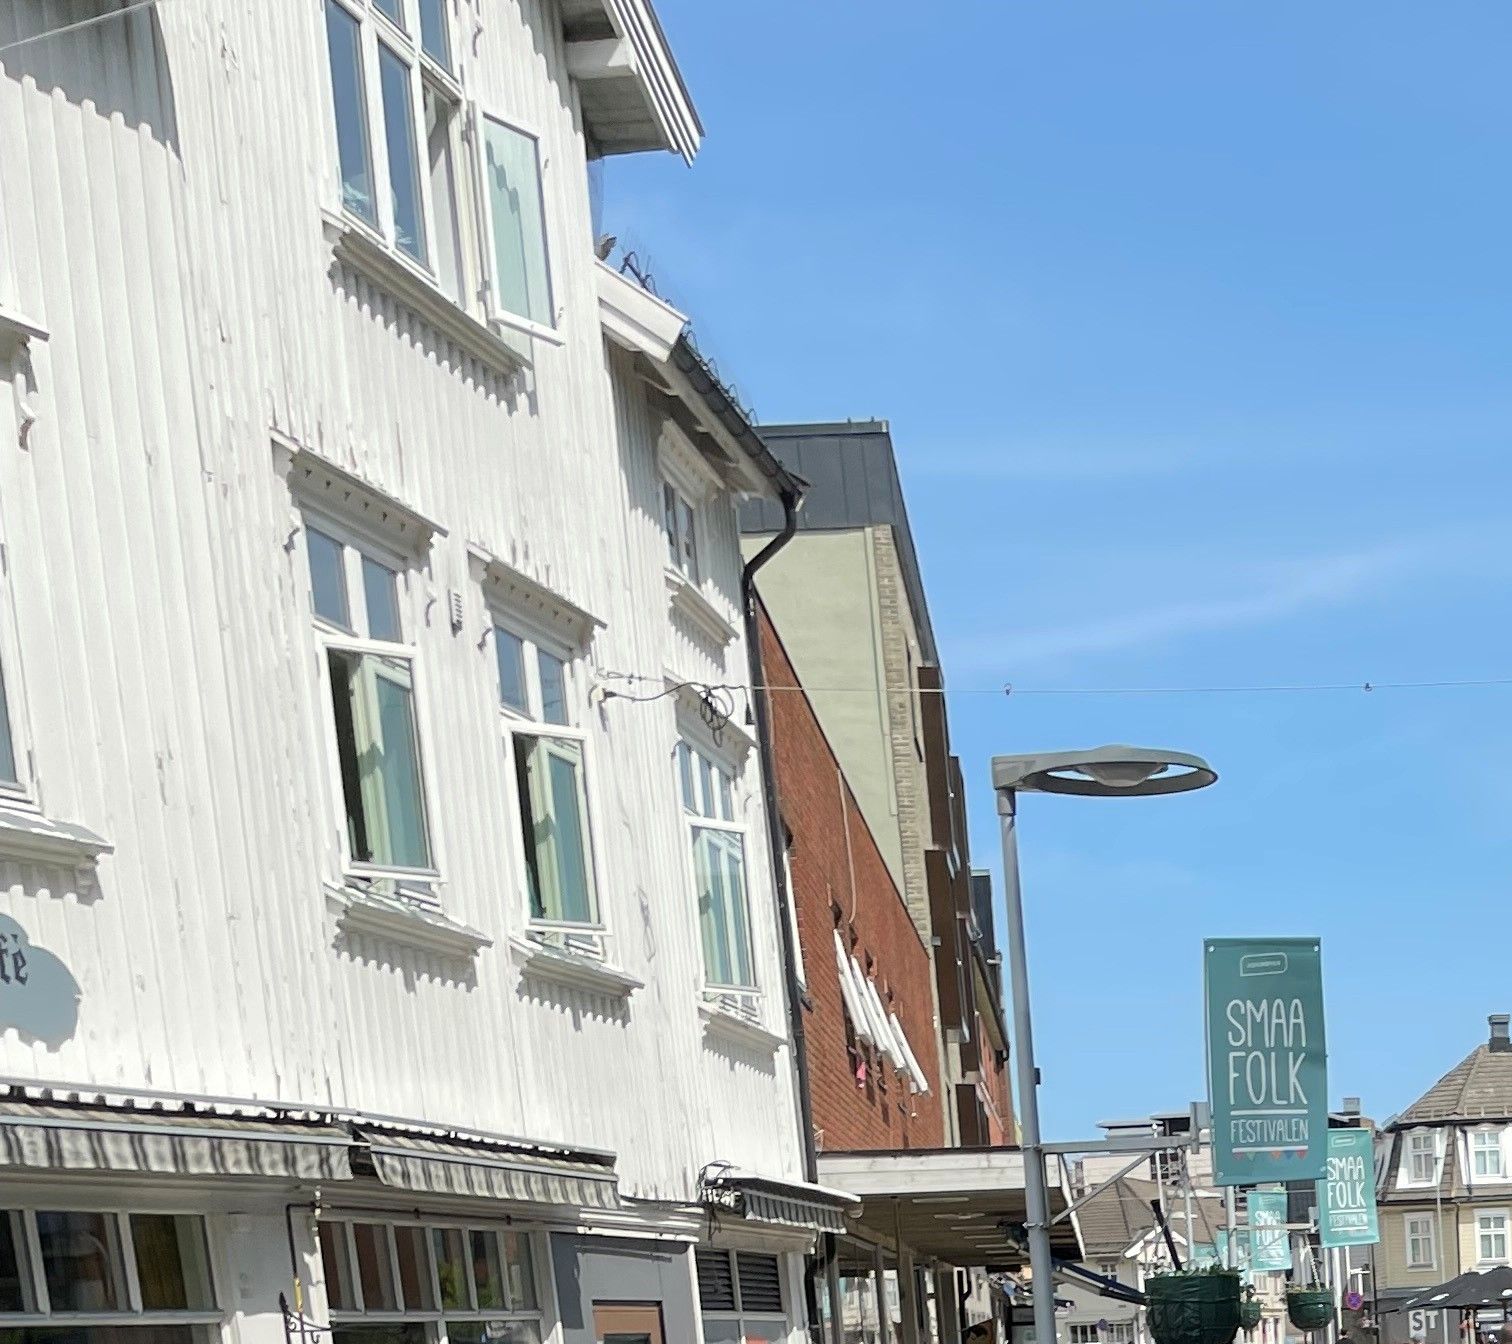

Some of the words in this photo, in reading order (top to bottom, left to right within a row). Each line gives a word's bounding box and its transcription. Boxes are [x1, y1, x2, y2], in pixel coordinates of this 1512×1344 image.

[1226, 999, 1307, 1048] SMAA
[1229, 1051, 1308, 1105] FOLK
[1231, 1118, 1309, 1144] FESTIVALEN
[1327, 1156, 1366, 1181] SMAA
[1327, 1181, 1367, 1209] FOLK
